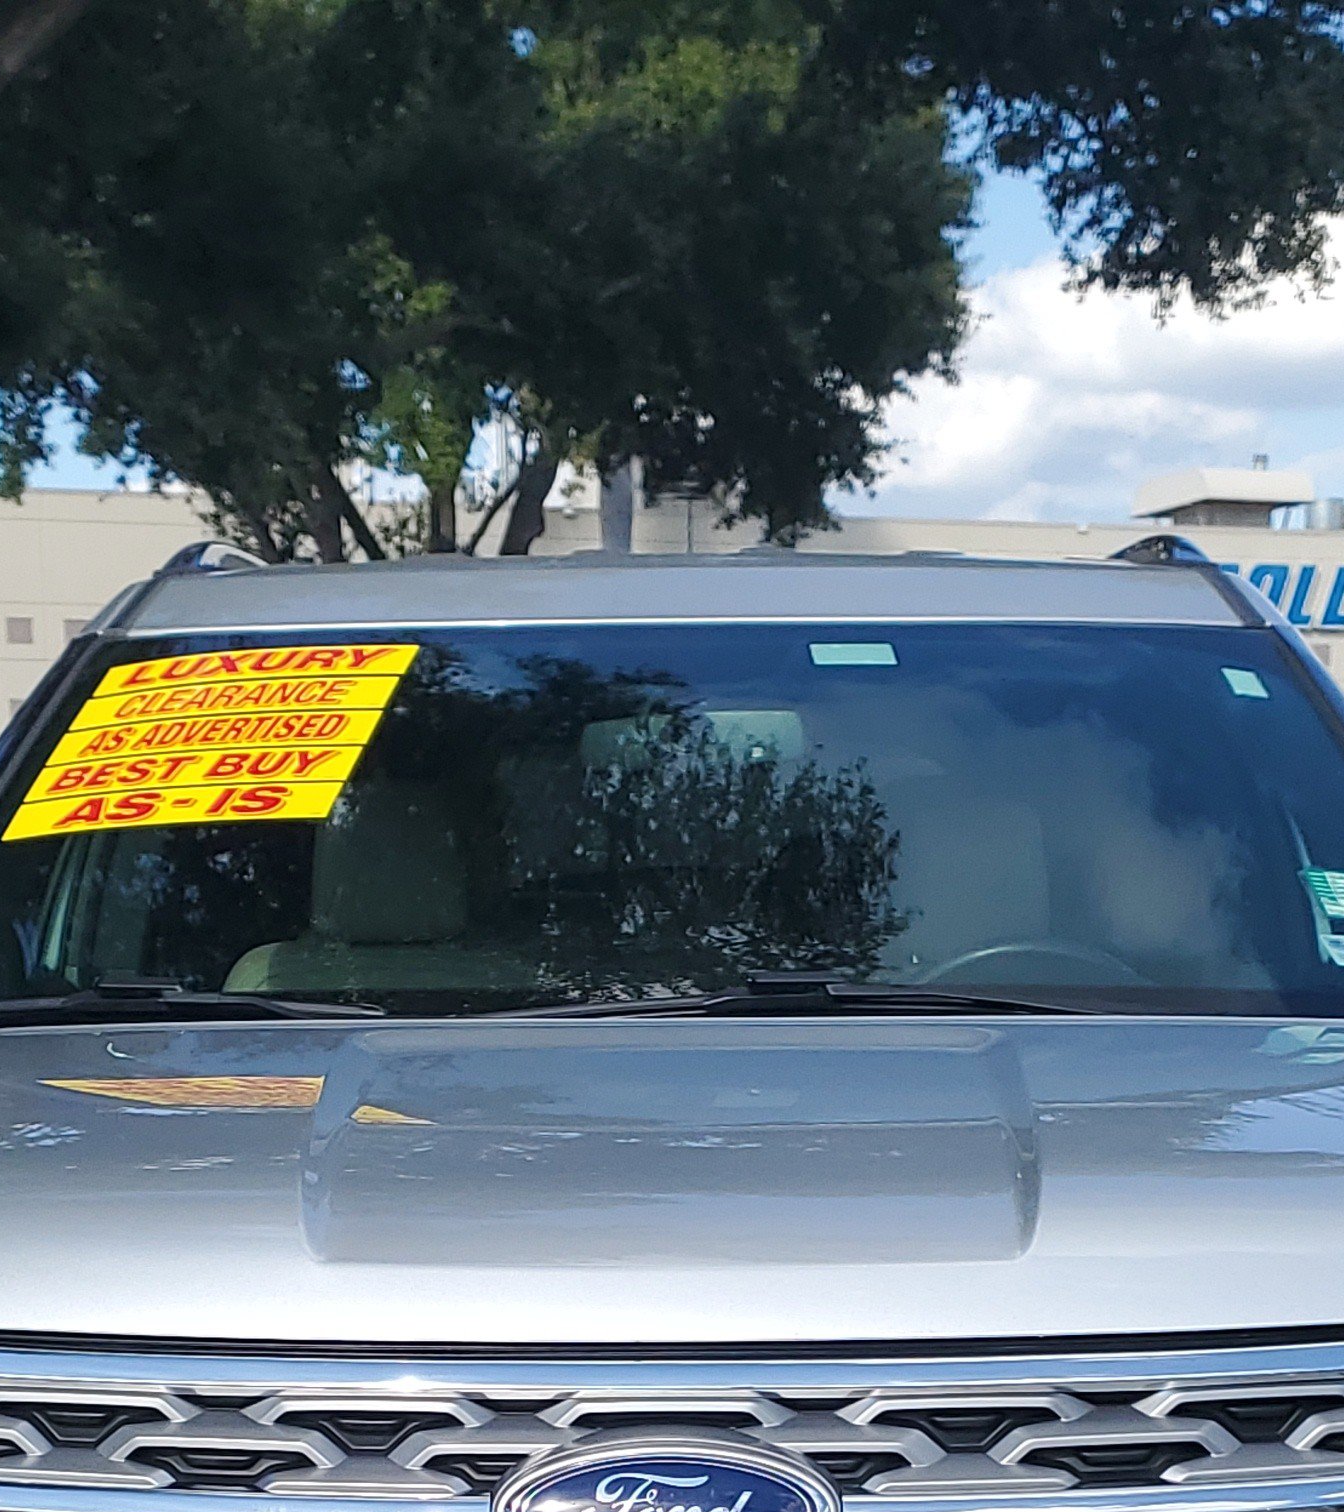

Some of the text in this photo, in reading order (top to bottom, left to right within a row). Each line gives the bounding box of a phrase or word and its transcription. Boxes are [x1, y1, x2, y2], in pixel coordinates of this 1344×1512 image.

[120, 647, 394, 688] LUXURY
[114, 679, 357, 719] CLEARANCE
[79, 712, 349, 758] AS ADVERTISED
[46, 750, 340, 794] BEST BUY
